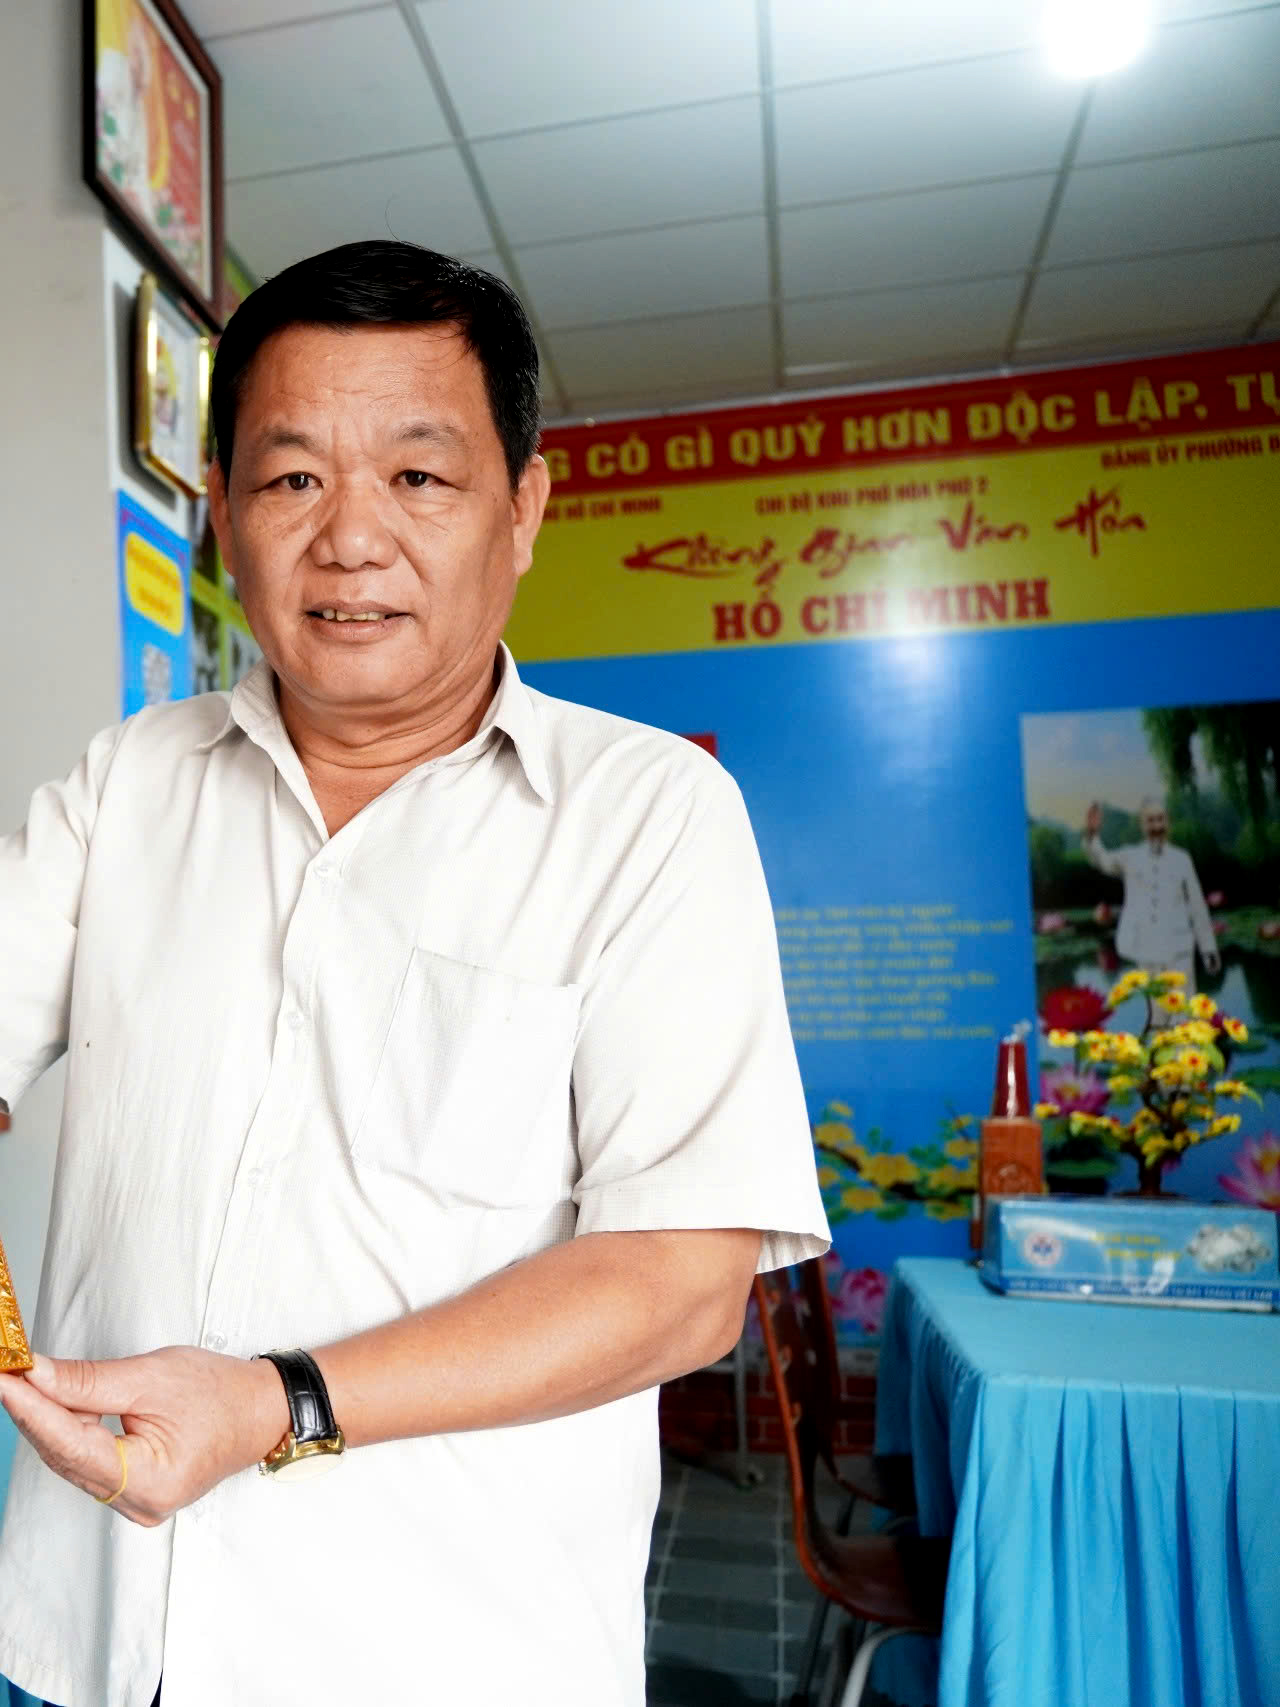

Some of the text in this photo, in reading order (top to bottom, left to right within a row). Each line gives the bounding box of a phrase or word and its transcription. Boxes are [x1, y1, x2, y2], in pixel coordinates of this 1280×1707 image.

[586, 432, 650, 479] CÓ
[664, 425, 714, 472] GÌ
[729, 413, 826, 468] QUÝ
[843, 406, 952, 456] HƠN
[967, 388, 1077, 444] ĐỘC
[976, 475, 989, 495] 2
[712, 586, 782, 642] HỒ
[906, 577, 1052, 628] MINH
